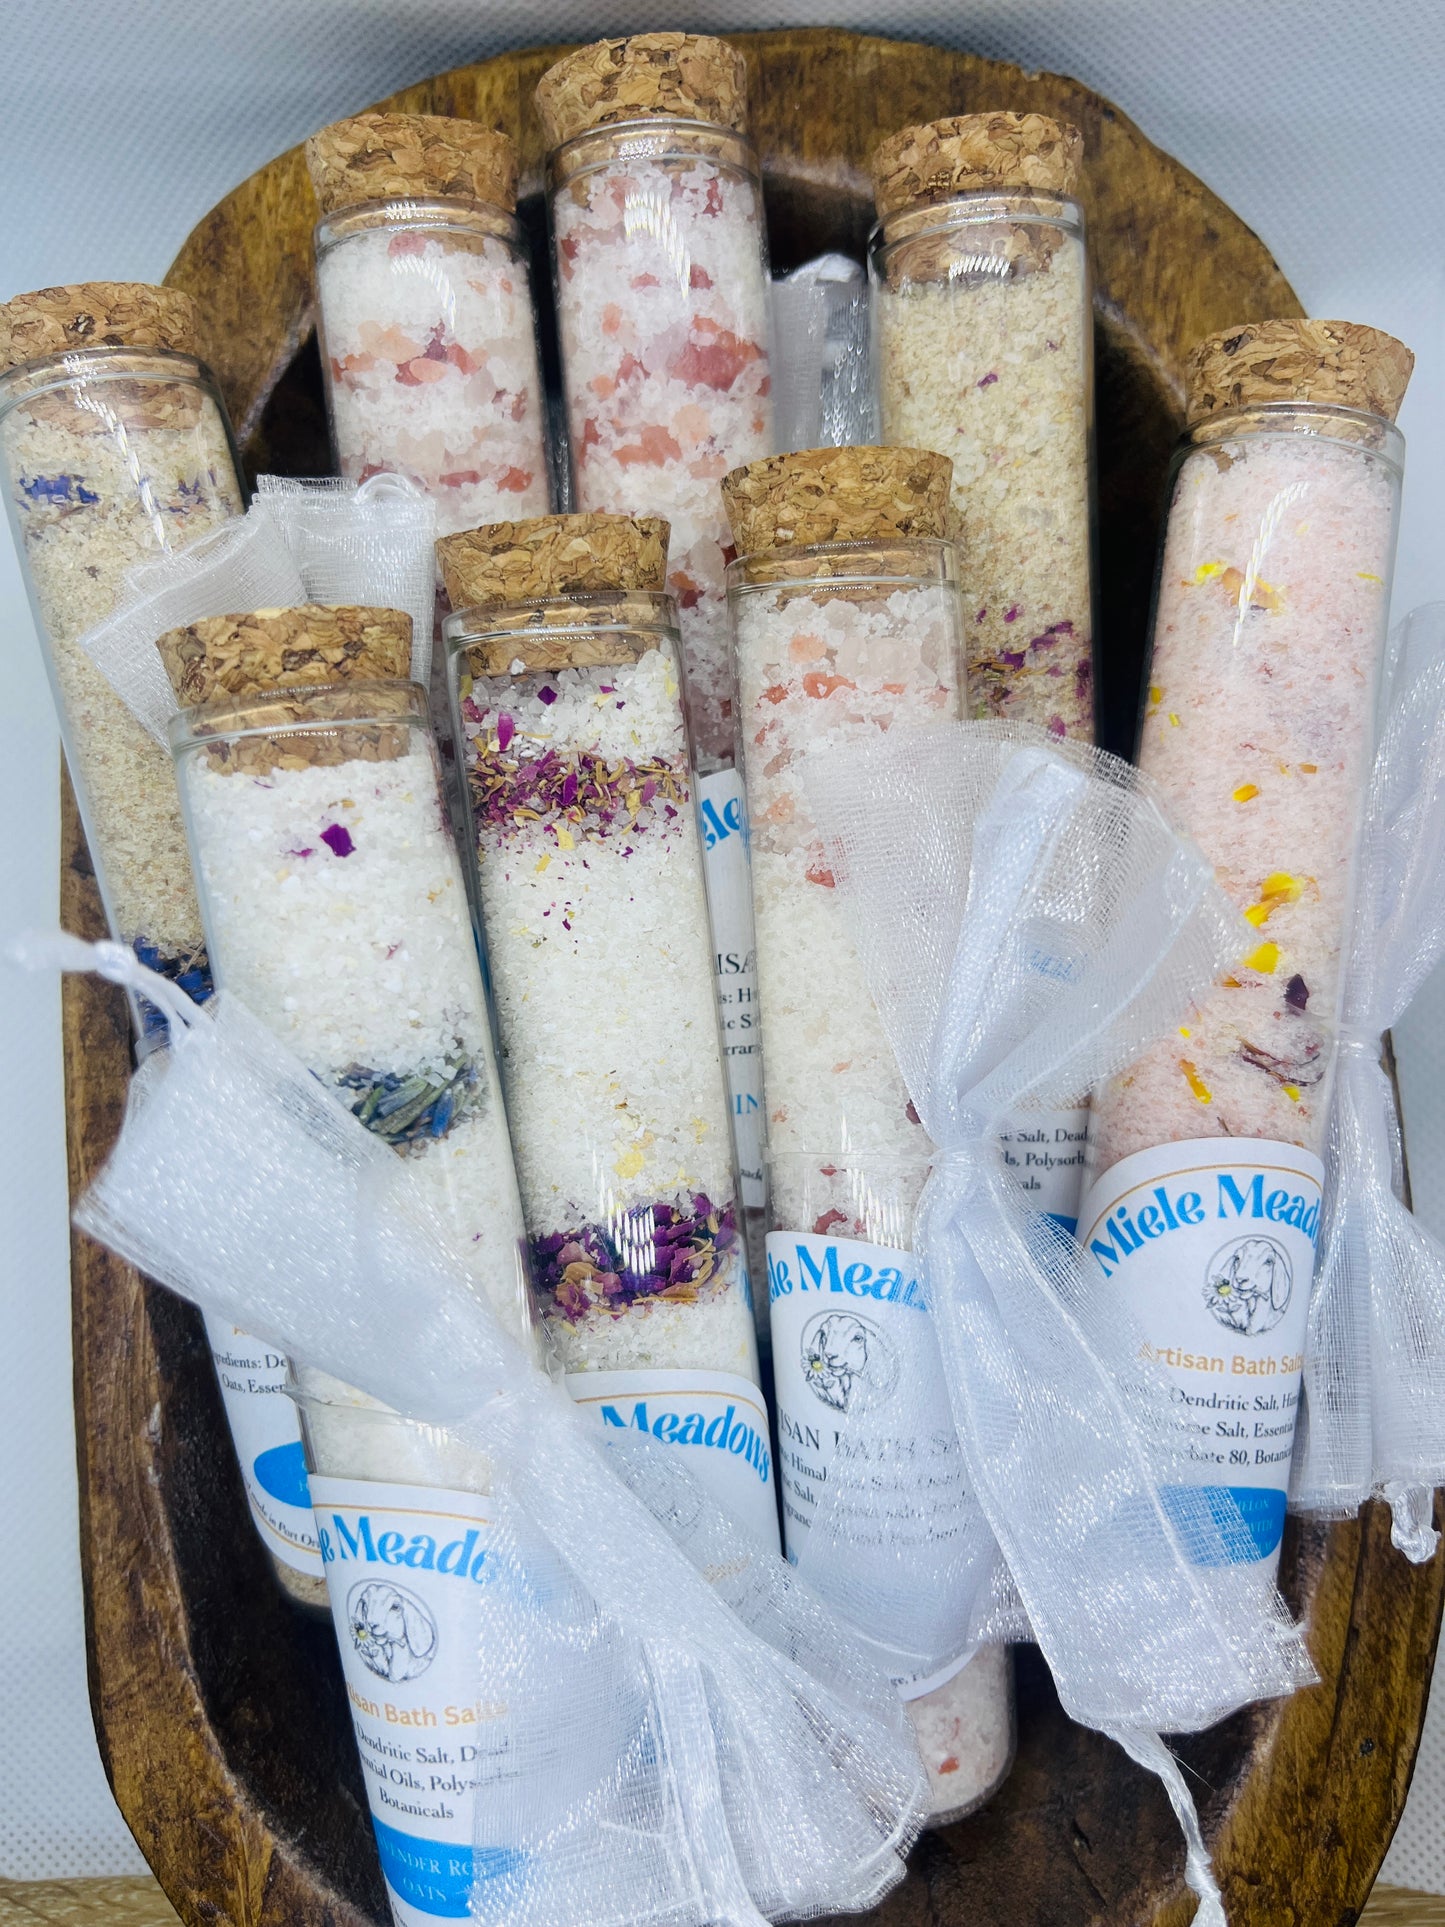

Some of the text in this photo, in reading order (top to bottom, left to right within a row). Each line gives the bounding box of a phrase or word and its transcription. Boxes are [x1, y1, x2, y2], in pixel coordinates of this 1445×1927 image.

[1055, 1125, 1088, 1143] Dead
[1026, 1150, 1086, 1171] Polysorb
[1089, 1174, 1322, 1278] Miele Mead
[1231, 1355, 1276, 1375] Bath
[1253, 1396, 1279, 1411] Salt,
[1215, 1421, 1249, 1439] Salt,
[1254, 1418, 1293, 1438] Essentia
[600, 1402, 770, 1483] Meadows
[1229, 1449, 1250, 1467] 80,
[384, 1703, 437, 1727] Bath
[356, 1721, 412, 1762] Dendritic
[390, 1768, 426, 1792] Oils,
[379, 1786, 454, 1819] Botanicals
